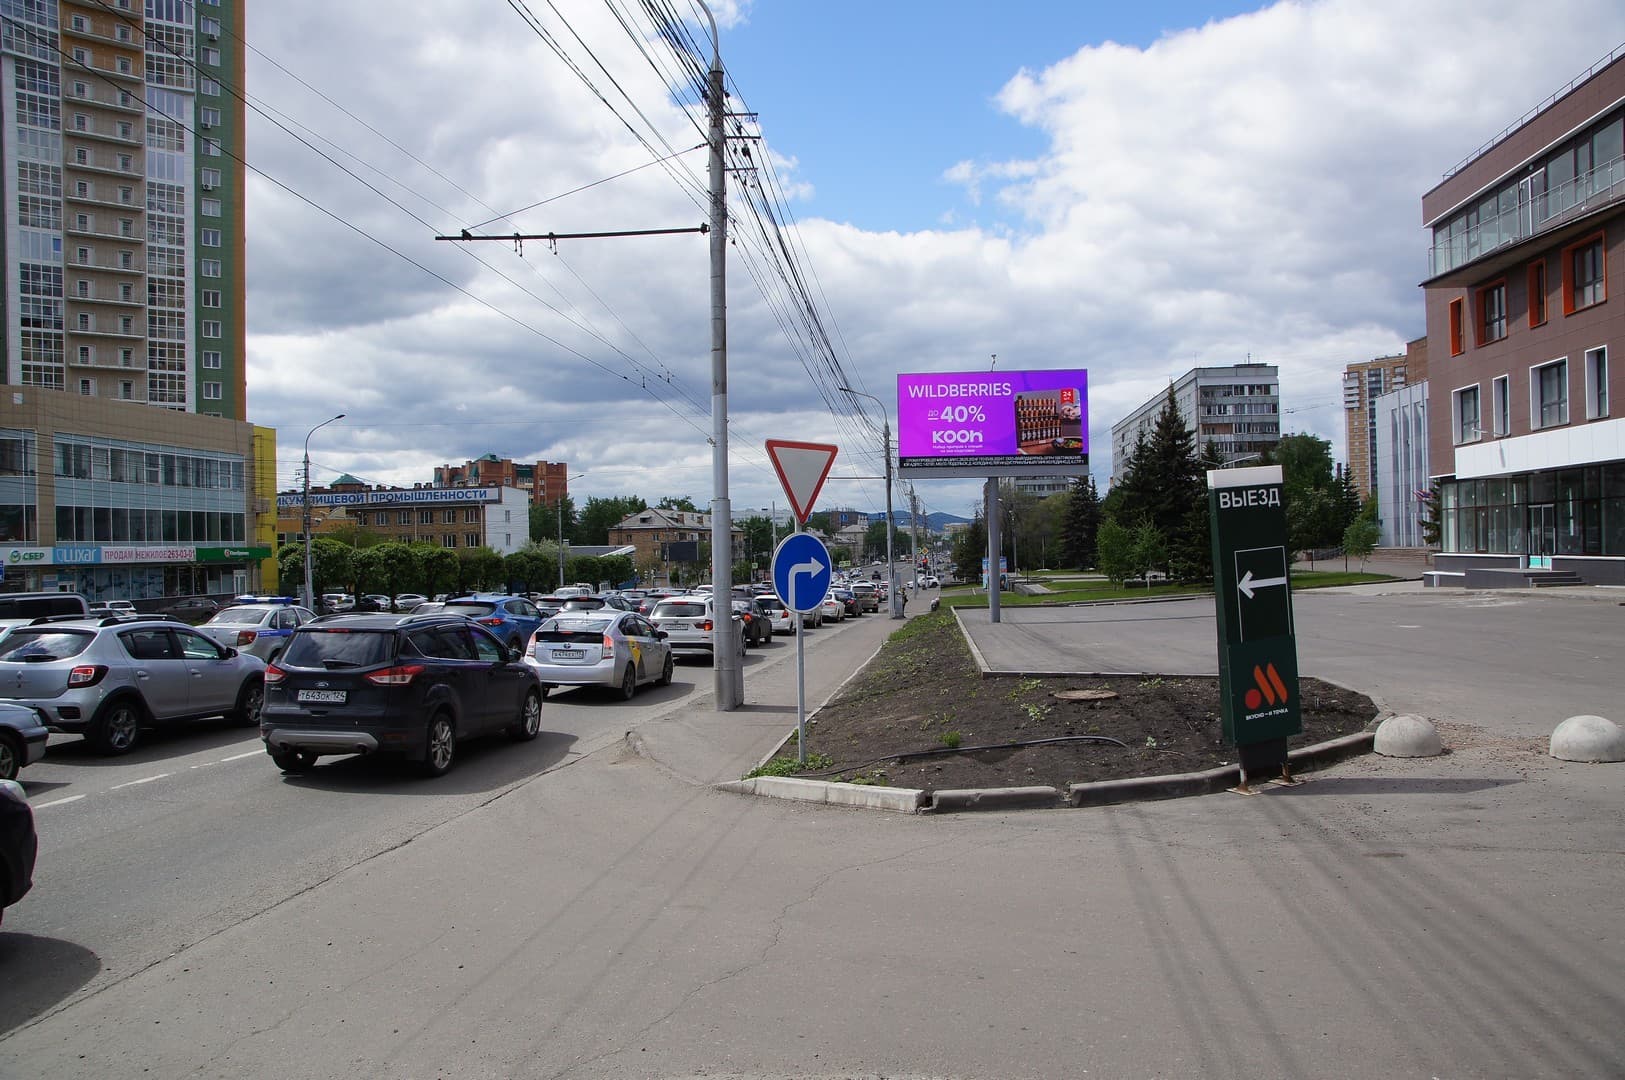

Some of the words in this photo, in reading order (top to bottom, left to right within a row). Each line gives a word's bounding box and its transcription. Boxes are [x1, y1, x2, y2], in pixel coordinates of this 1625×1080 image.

[908, 383, 1012, 398] WILDBERRIES
[370, 490, 488, 504] ПРОМЫШЛЕННОСТИ
[1219, 487, 1281, 509] ВЫЕЗД
[22, 552, 45, 561] СБЕР
[104, 550, 134, 561] ПРОДАМ
[135, 550, 168, 560] НЕЖИЛОЕ
